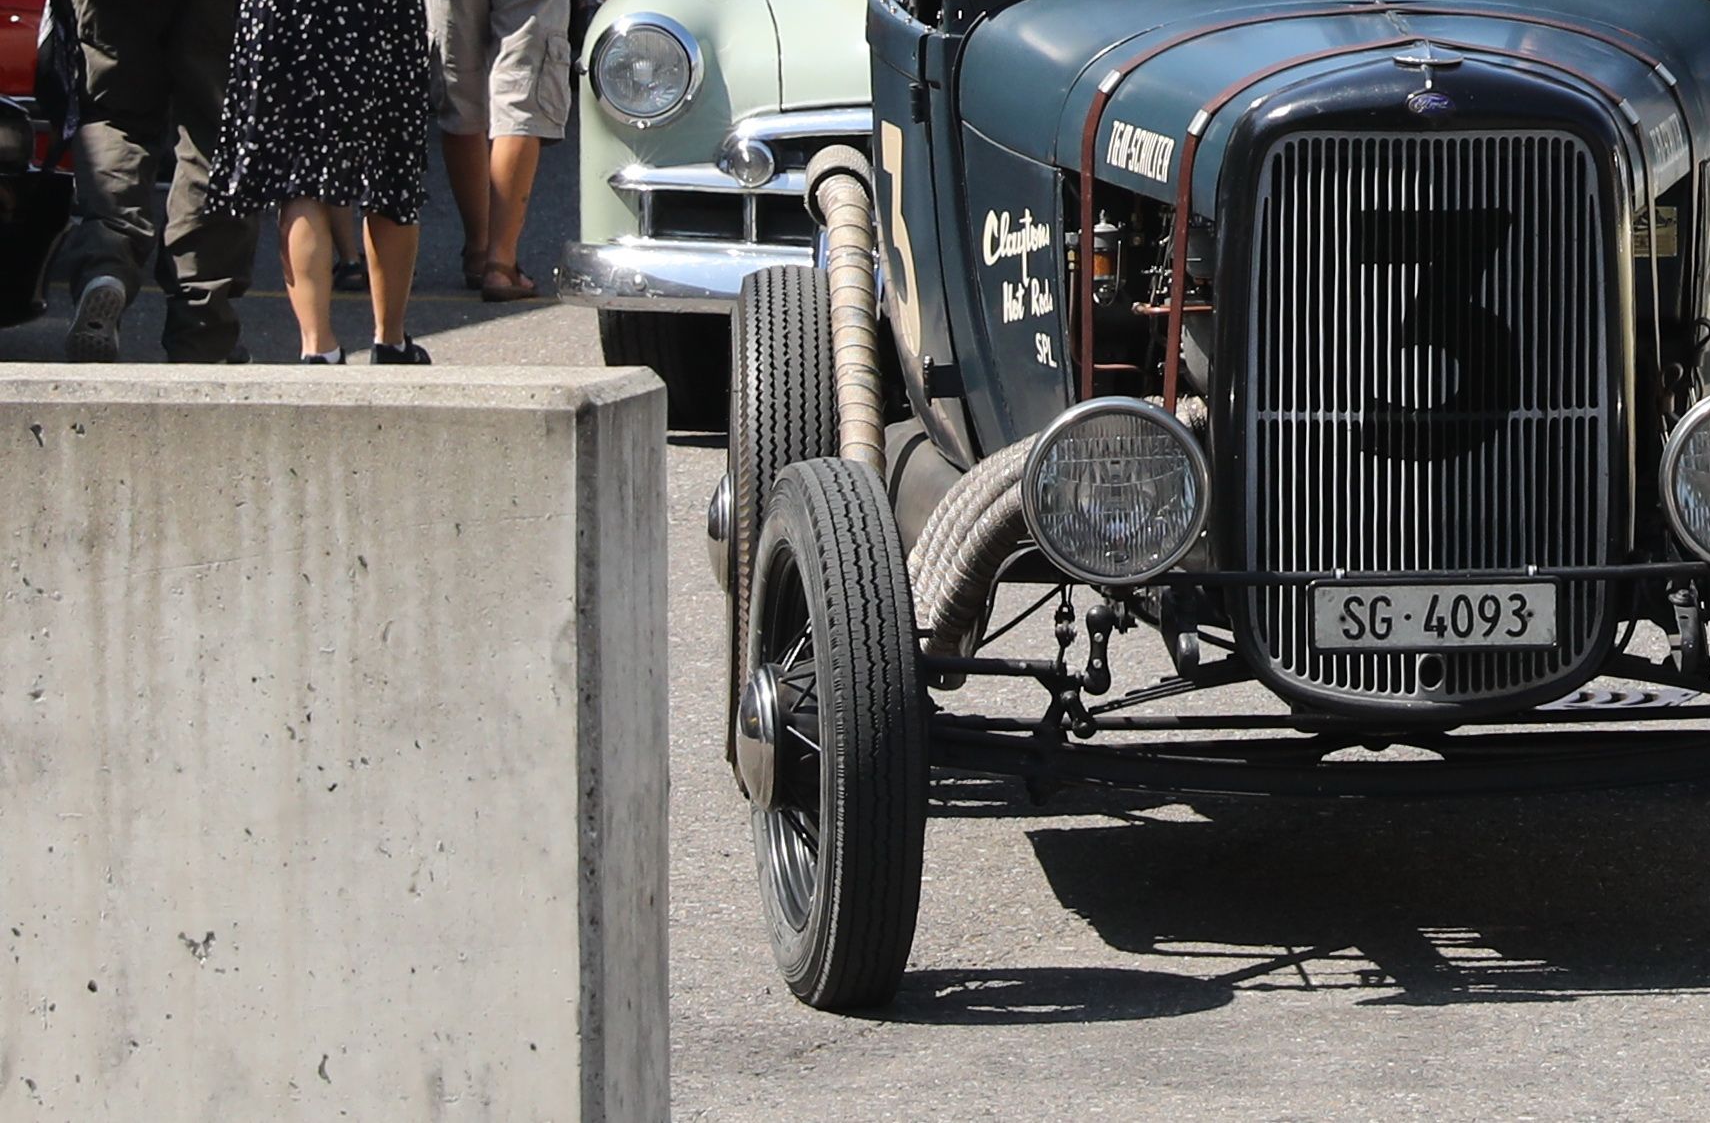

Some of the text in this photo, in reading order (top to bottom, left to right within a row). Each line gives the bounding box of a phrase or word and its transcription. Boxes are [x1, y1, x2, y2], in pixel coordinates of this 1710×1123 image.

[982, 208, 1051, 288] Claytons
[1002, 278, 1054, 324] Hot Rods
